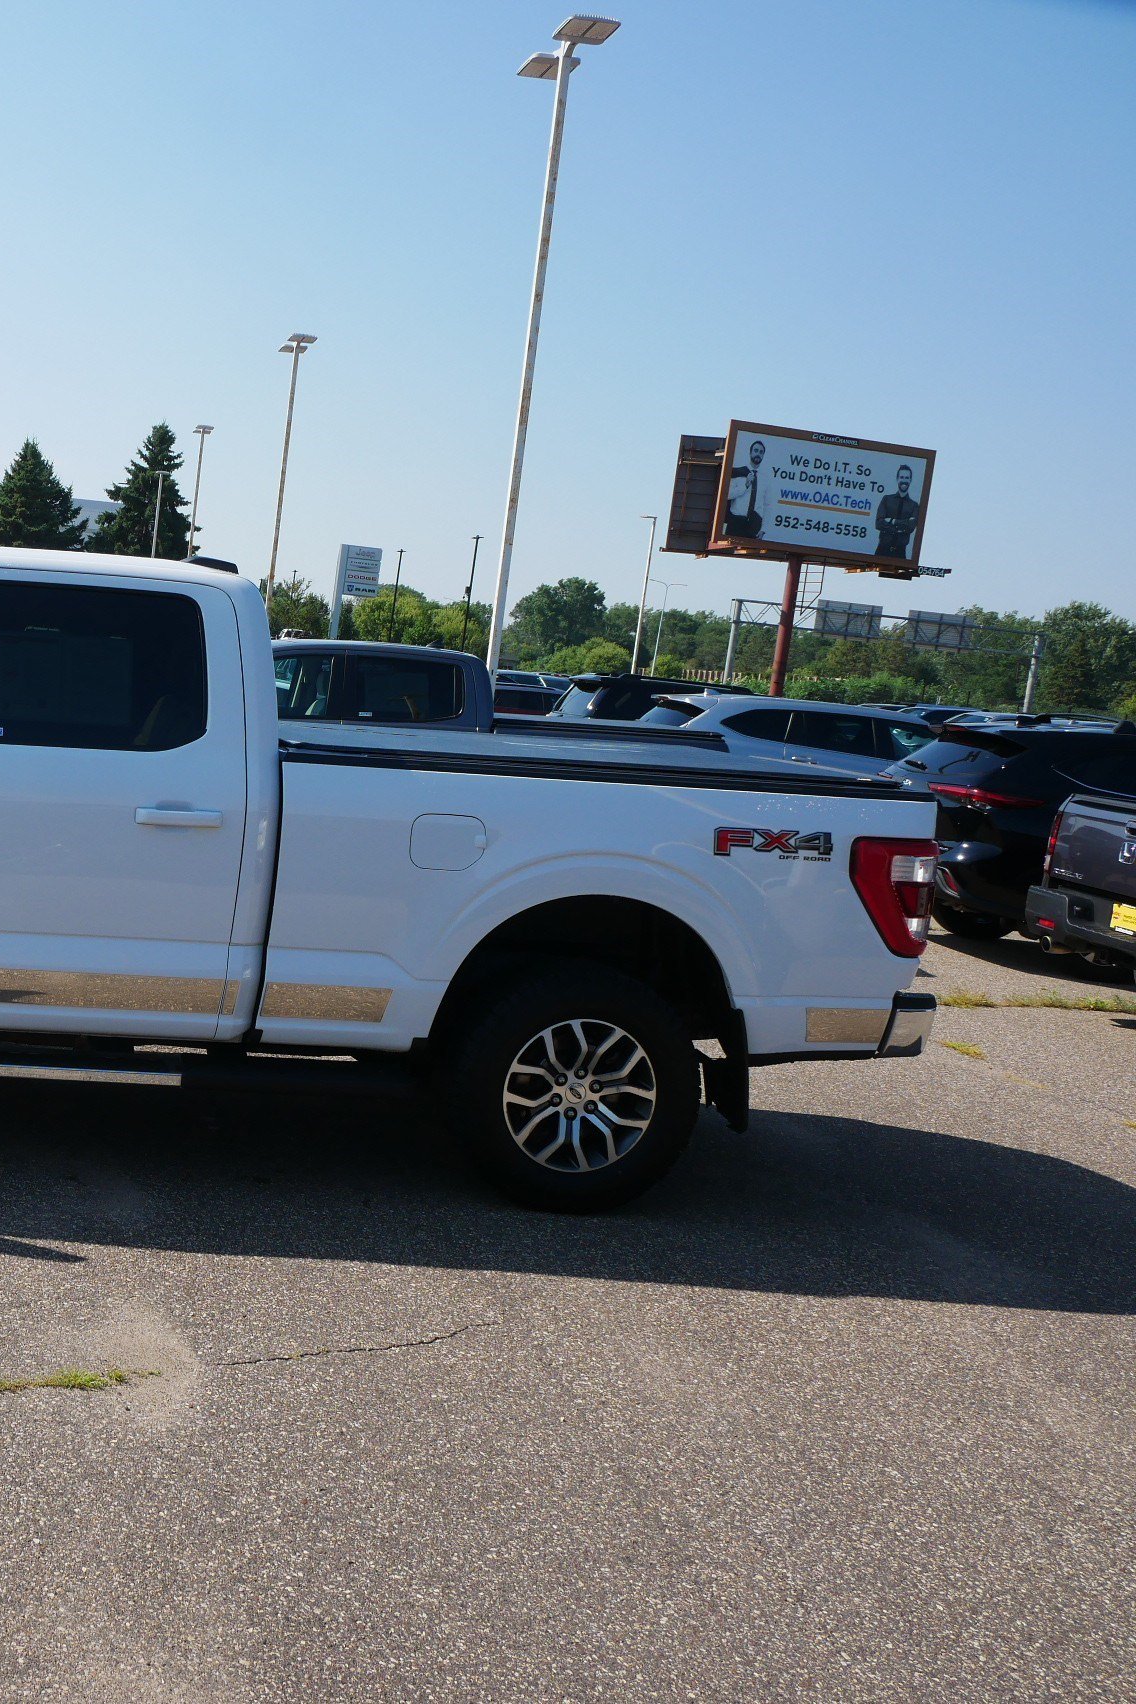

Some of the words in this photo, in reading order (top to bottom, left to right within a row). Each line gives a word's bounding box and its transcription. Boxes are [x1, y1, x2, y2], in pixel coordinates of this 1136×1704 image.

[790, 454, 809, 468] We
[814, 458, 830, 471] Do
[834, 461, 852, 475] I.T.
[856, 464, 872, 477] So
[772, 467, 795, 481] You
[799, 471, 831, 486] Don't
[835, 477, 865, 491] Have
[870, 481, 885, 493] To
[780, 489, 872, 511] www.OAC.Tech
[774, 515, 867, 539] 952-548-5558
[347, 574, 378, 582] DODGE
[714, 826, 834, 857] FX4
[803, 855, 831, 863] ROAD
